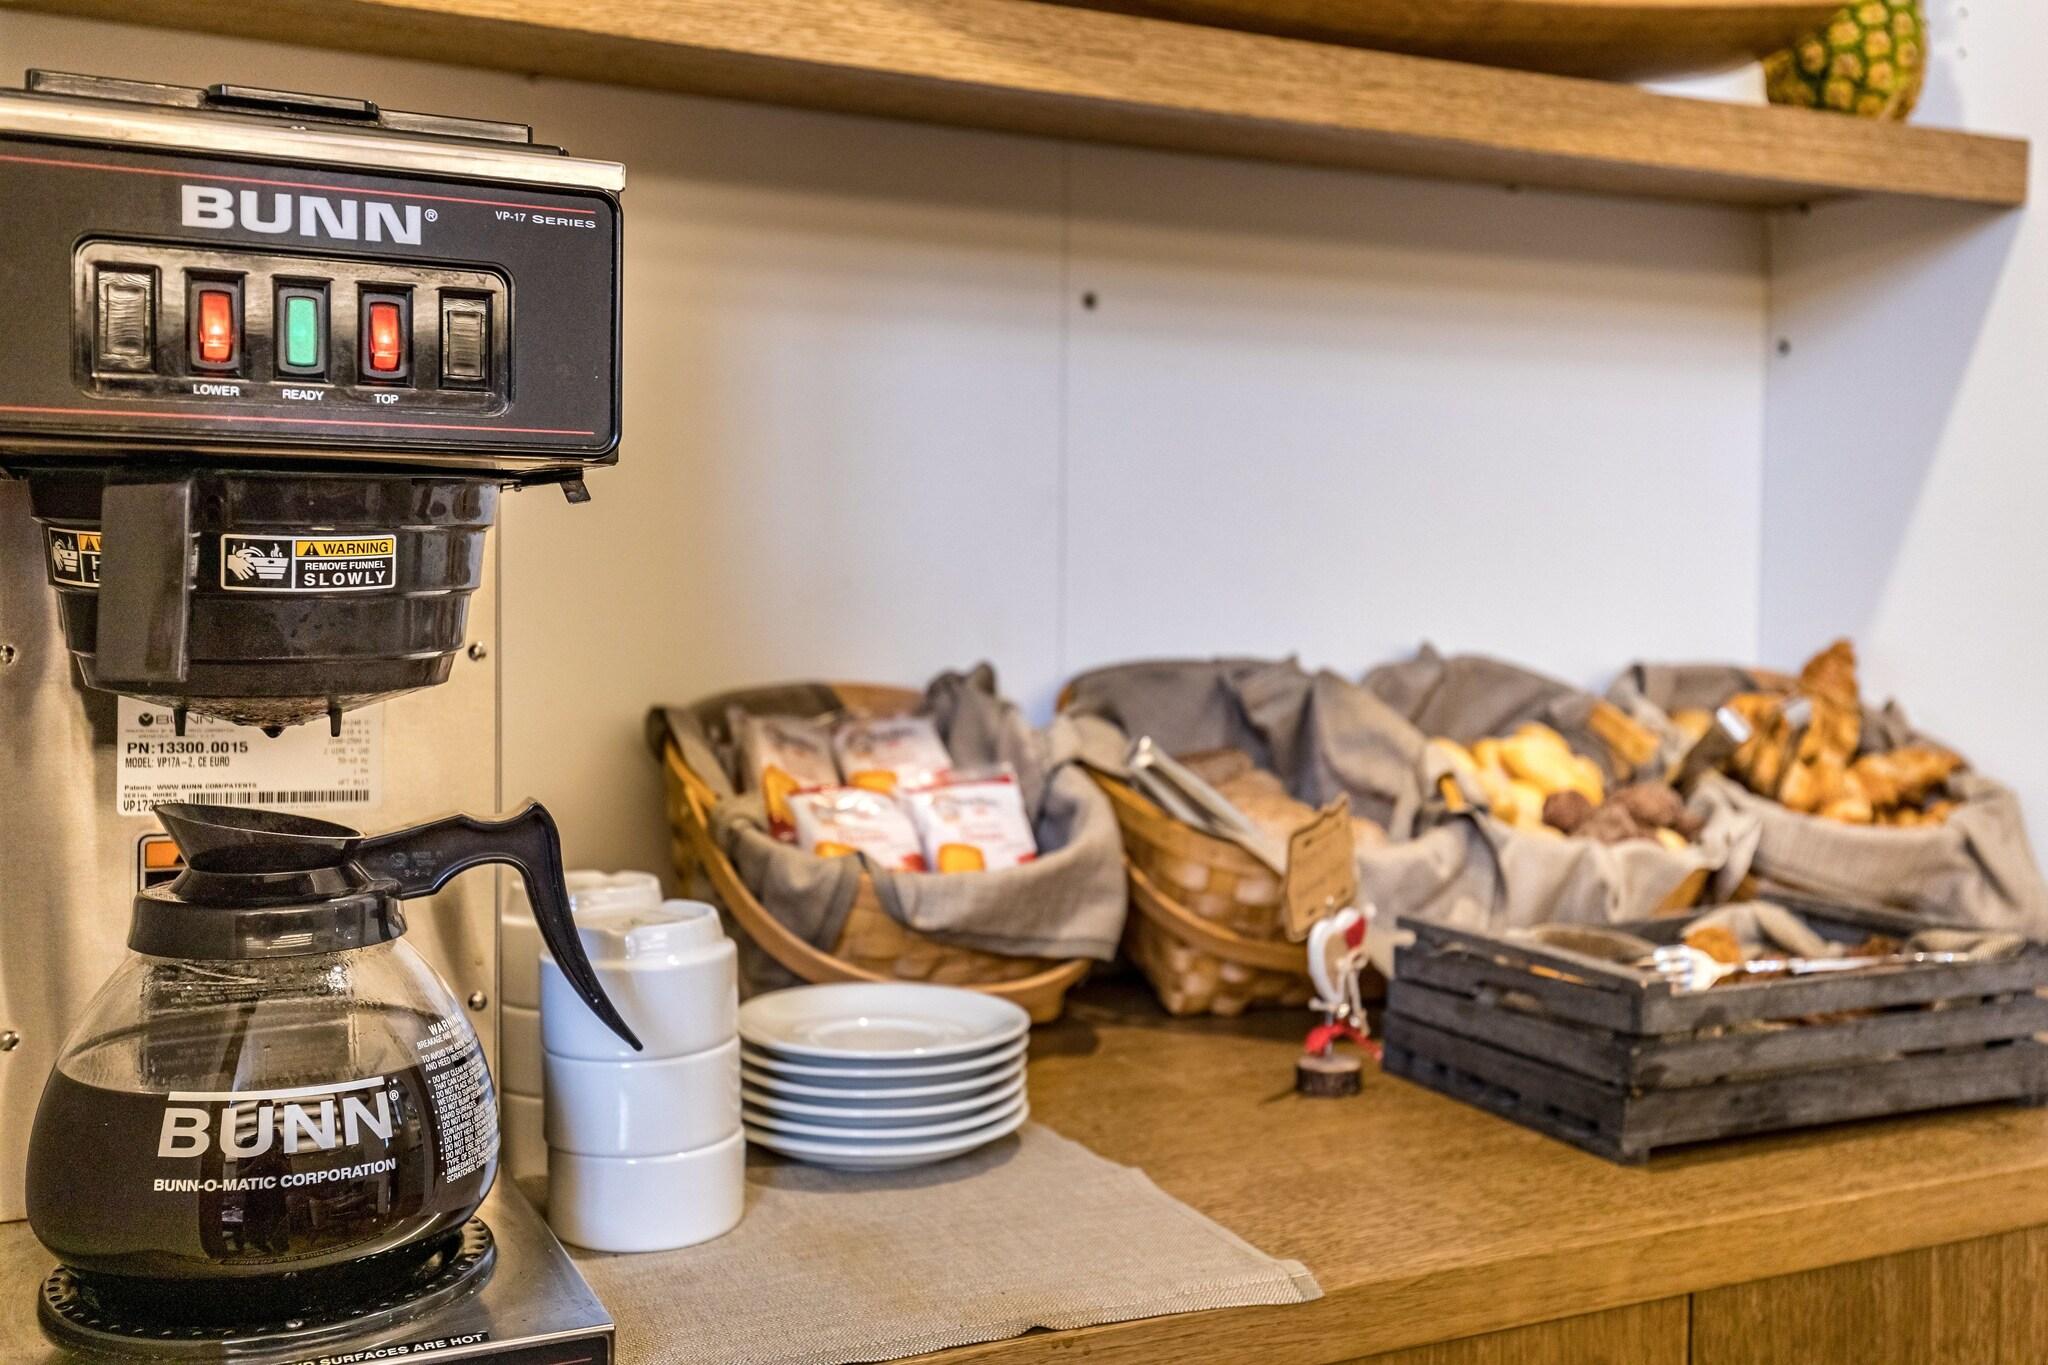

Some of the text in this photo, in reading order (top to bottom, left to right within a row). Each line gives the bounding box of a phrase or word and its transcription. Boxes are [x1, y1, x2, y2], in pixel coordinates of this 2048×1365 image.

[495, 210, 597, 229] VP-17 SERIES
[192, 383, 240, 397] LOWER
[282, 388, 325, 401] READY
[374, 393, 400, 405] TOP
[322, 541, 389, 555] WARNING
[304, 560, 386, 571] REMOVE FUNNEL
[303, 570, 386, 587] SLOWLY
[156, 714, 214, 725] BNN
[127, 741, 249, 755] PN:13300.0015
[198, 756, 207, 768] CE
[209, 756, 230, 768] EURO
[421, 1054, 430, 1064] TO
[430, 1048, 446, 1061] AVOID
[445, 1044, 455, 1054] THE
[425, 1061, 438, 1073] AND
[438, 1056, 451, 1068] HEED
[431, 1075, 441, 1084] DO
[440, 1071, 450, 1082] NOT
[450, 1066, 464, 1078] CLEAN
[434, 1080, 448, 1091] THAT
[447, 1077, 457, 1087] CAN
[435, 1090, 444, 1099] DO
[444, 1086, 455, 1096] NOT
[454, 1081, 468, 1093] PLACE
[439, 1105, 448, 1114] DO
[447, 1100, 459, 1111] NOT
[440, 1110, 456, 1122] HARD
[442, 1120, 451, 1130] DO
[450, 1115, 461, 1127] NOT
[461, 1109, 474, 1122] POUR
[444, 1135, 453, 1145] DO
[452, 1130, 464, 1141] NOT
[463, 1124, 475, 1137] HEAT
[445, 1143, 454, 1152] DO
[453, 1138, 465, 1149] NOT
[464, 1133, 475, 1144] BOIL
[446, 1151, 454, 1160] DO
[454, 1146, 465, 1157] NOT
[465, 1141, 475, 1152] USE
[446, 1156, 460, 1168] TYPE
[460, 1152, 468, 1161] OF
[446, 1154, 478, 1175] IMMEDIATELY
[153, 1157, 397, 1193] BUNN-O-MATIC CORPORATION
[319, 1333, 483, 1365] SURFACES ARE HOT
